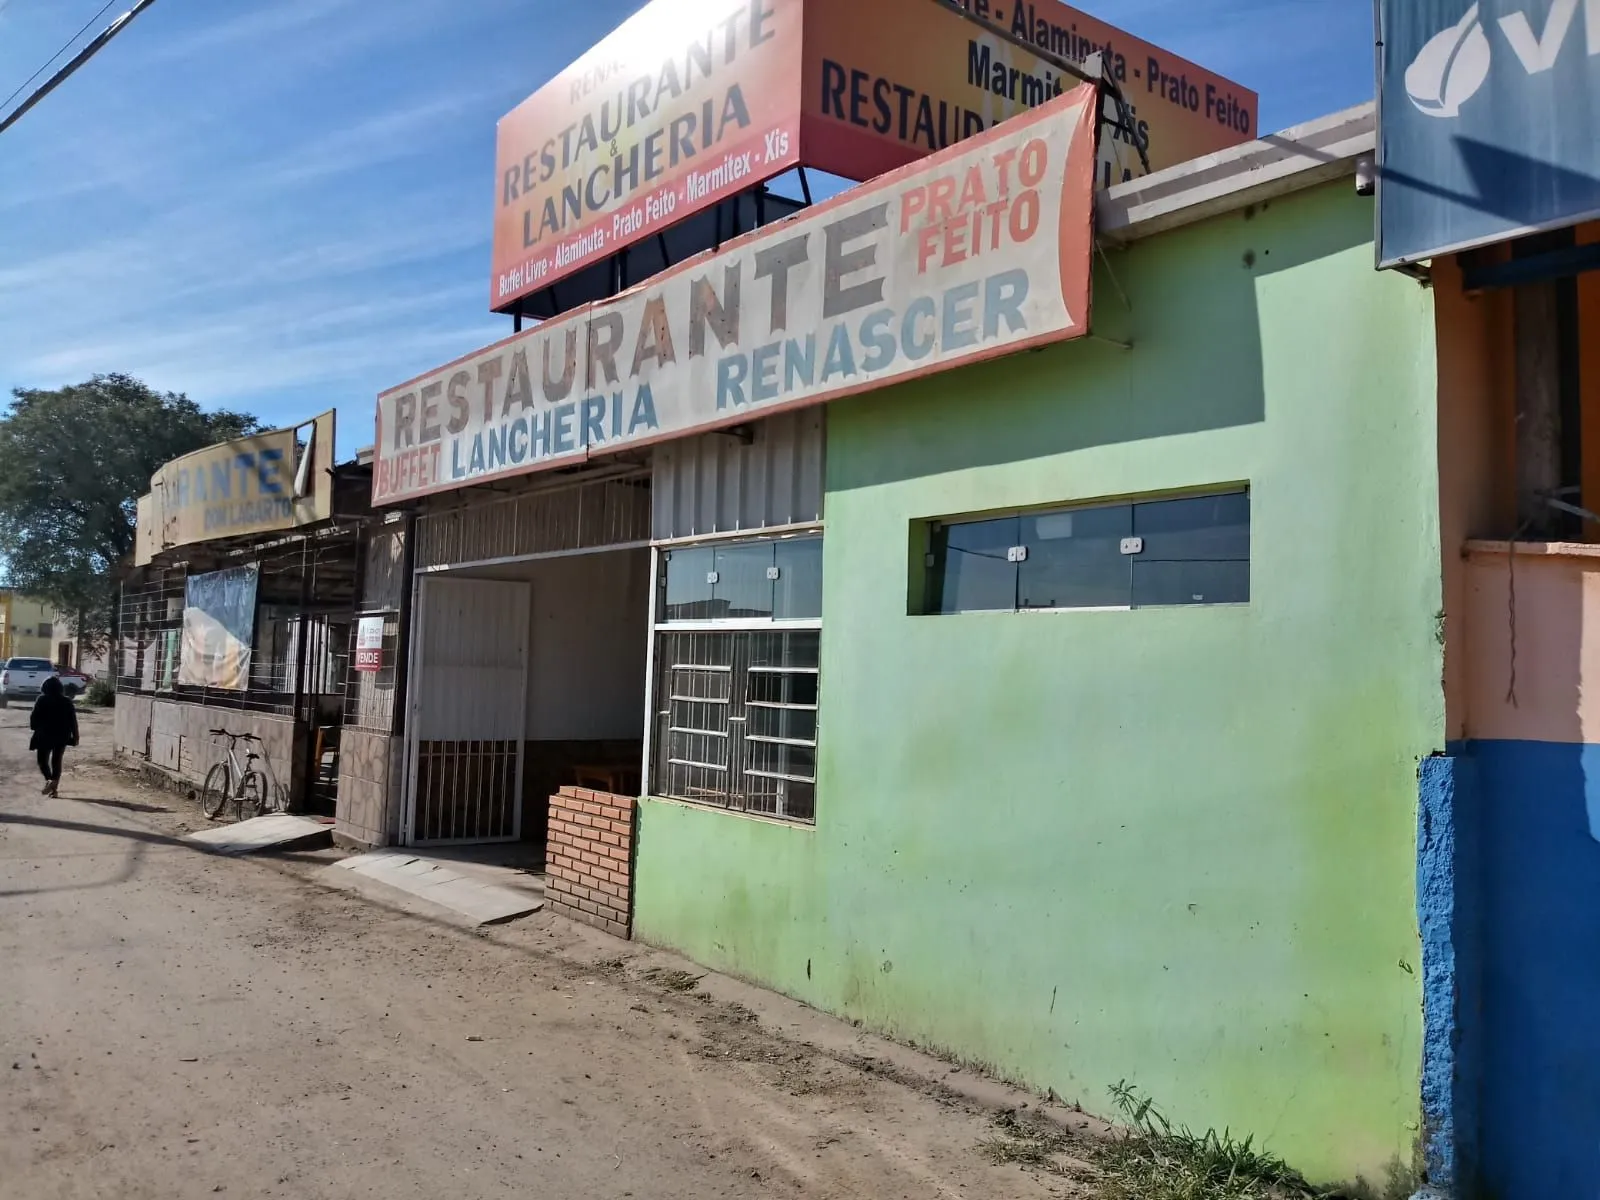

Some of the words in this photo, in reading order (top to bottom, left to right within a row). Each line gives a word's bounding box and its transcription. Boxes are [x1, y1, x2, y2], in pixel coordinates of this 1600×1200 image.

[503, 0, 776, 207] RESTAURANTE
[968, 39, 1063, 108] Marmit
[1011, 1, 1126, 83] Alaminta
[1147, 55, 1200, 112] Prato
[1205, 83, 1250, 135] Feito
[499, 264, 524, 297] Buffet
[525, 259, 548, 285] Livre
[555, 229, 604, 270] Alaminuta
[613, 209, 643, 241] Prato
[645, 191, 676, 224] Feito
[686, 152, 751, 204] Marmitex
[764, 128, 789, 165] Xis
[523, 82, 751, 249] LANCHERIA
[900, 138, 1048, 236] PRATO
[916, 189, 1041, 275] FEITO
[378, 444, 442, 498] BUFFET
[452, 381, 660, 479] LANCHERIA
[716, 268, 1029, 410] RENASCER
[393, 201, 890, 451] RESTAURANTE
